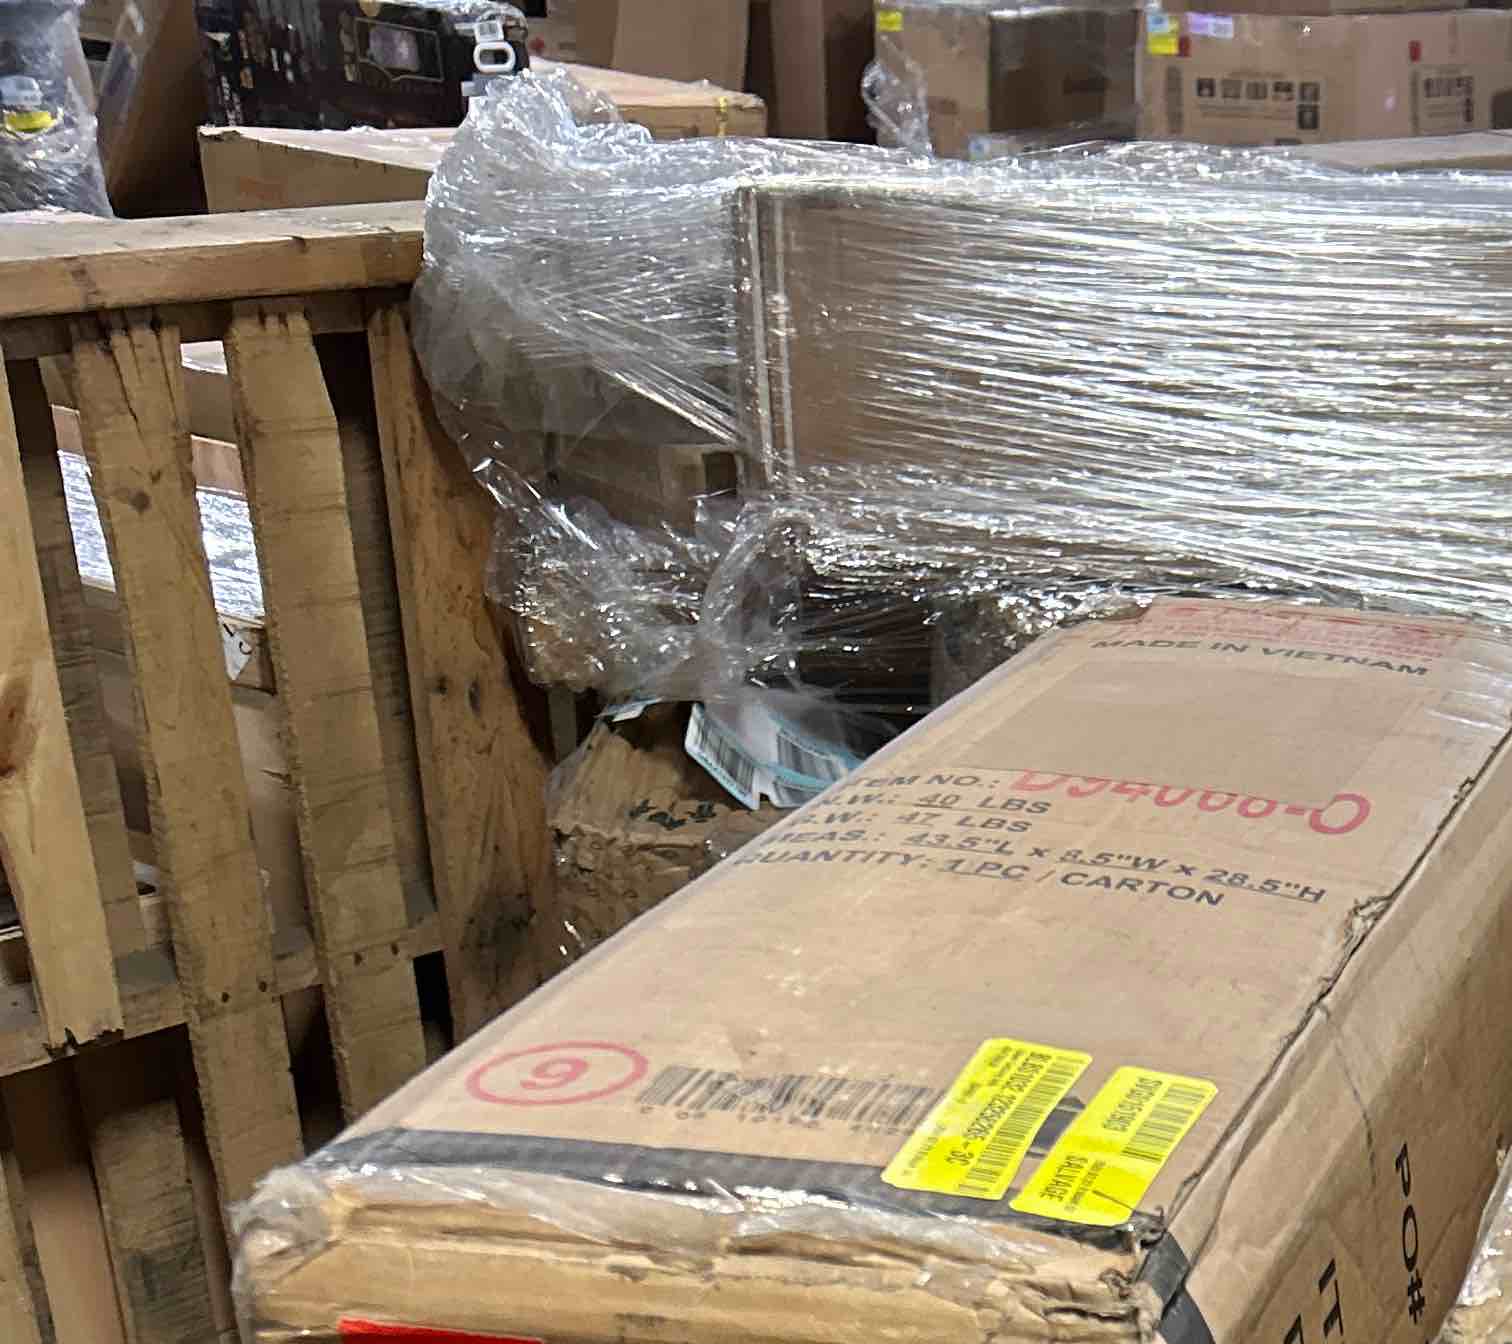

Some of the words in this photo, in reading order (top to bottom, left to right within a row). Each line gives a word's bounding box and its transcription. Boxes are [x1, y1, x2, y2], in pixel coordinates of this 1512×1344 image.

[1090, 639, 1200, 650] MADE
[1210, 641, 1248, 654] IN
[1261, 646, 1429, 676] VIETNAM
[913, 793, 961, 808] 40
[978, 796, 1052, 815] LBS
[956, 815, 1032, 833] LBS
[974, 861, 1030, 881] PC
[1060, 871, 1225, 906] CARTON
[1203, 868, 1327, 904] 28.5"H
[1395, 1142, 1426, 1325] PO#
